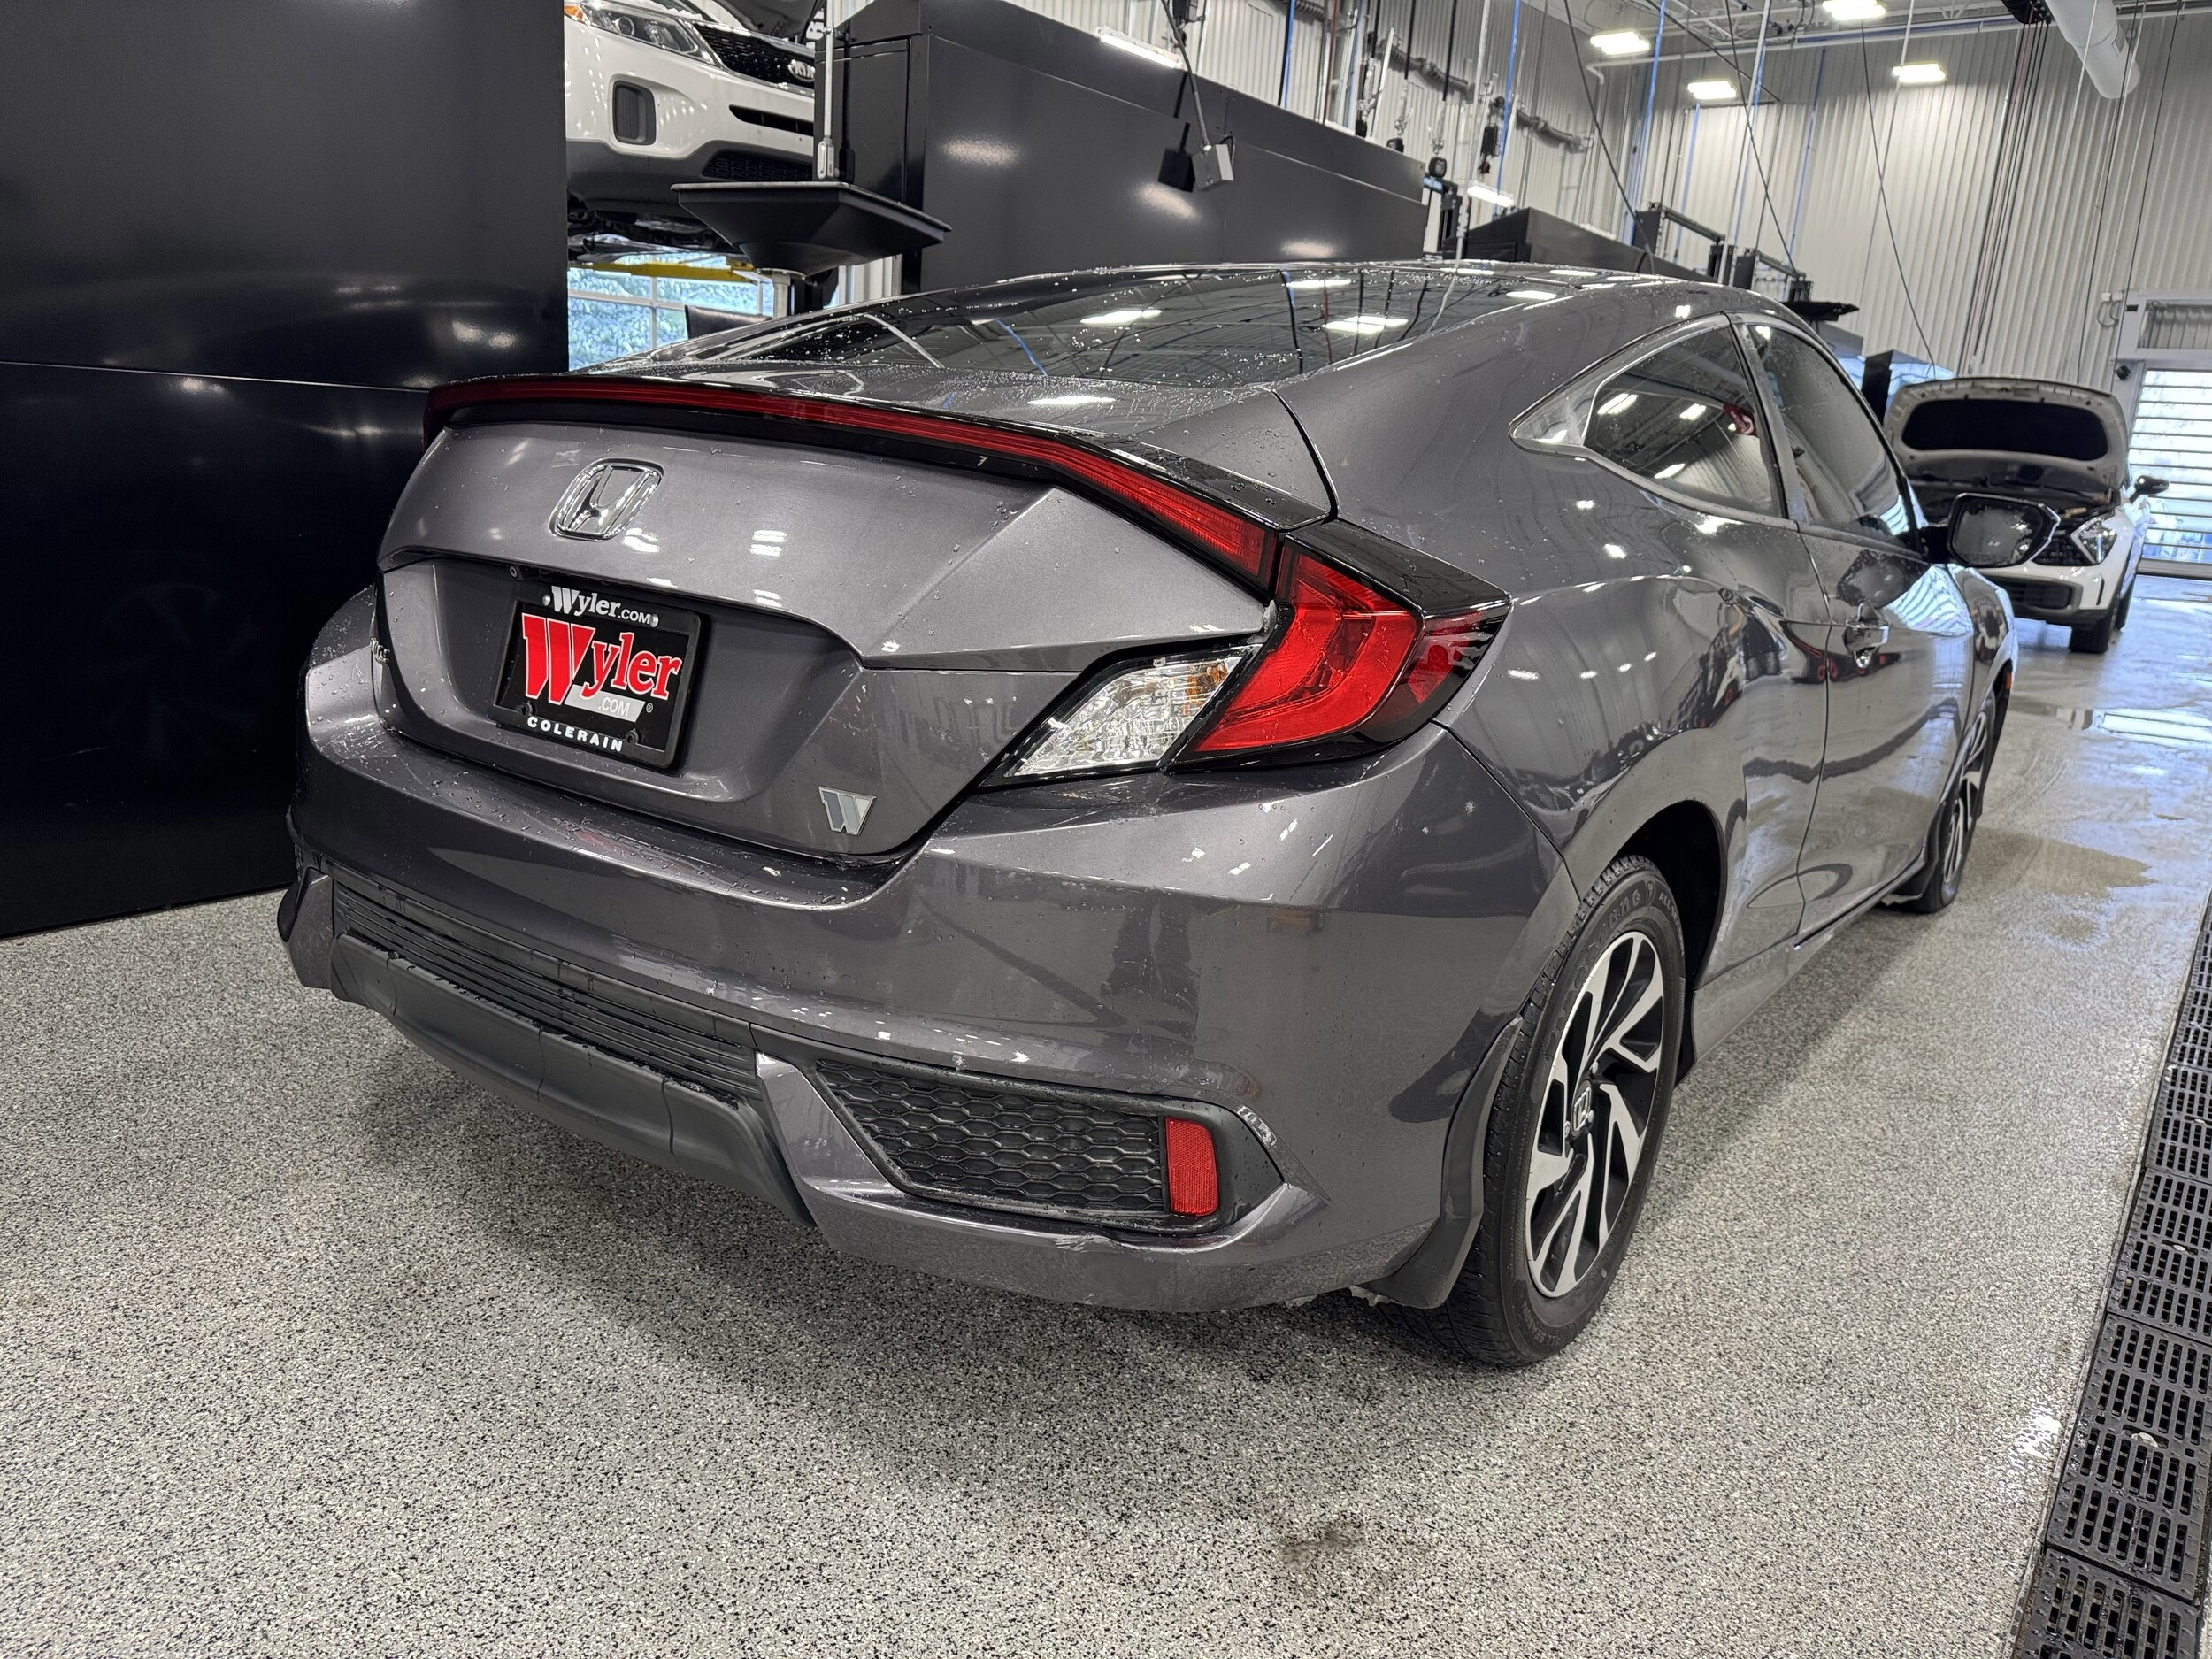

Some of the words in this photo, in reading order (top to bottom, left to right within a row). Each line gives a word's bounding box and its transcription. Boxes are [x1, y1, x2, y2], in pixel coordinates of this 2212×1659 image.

[522, 612, 682, 706] Wyler
[598, 696, 630, 717] .COM
[527, 717, 624, 752] COLERAIN
